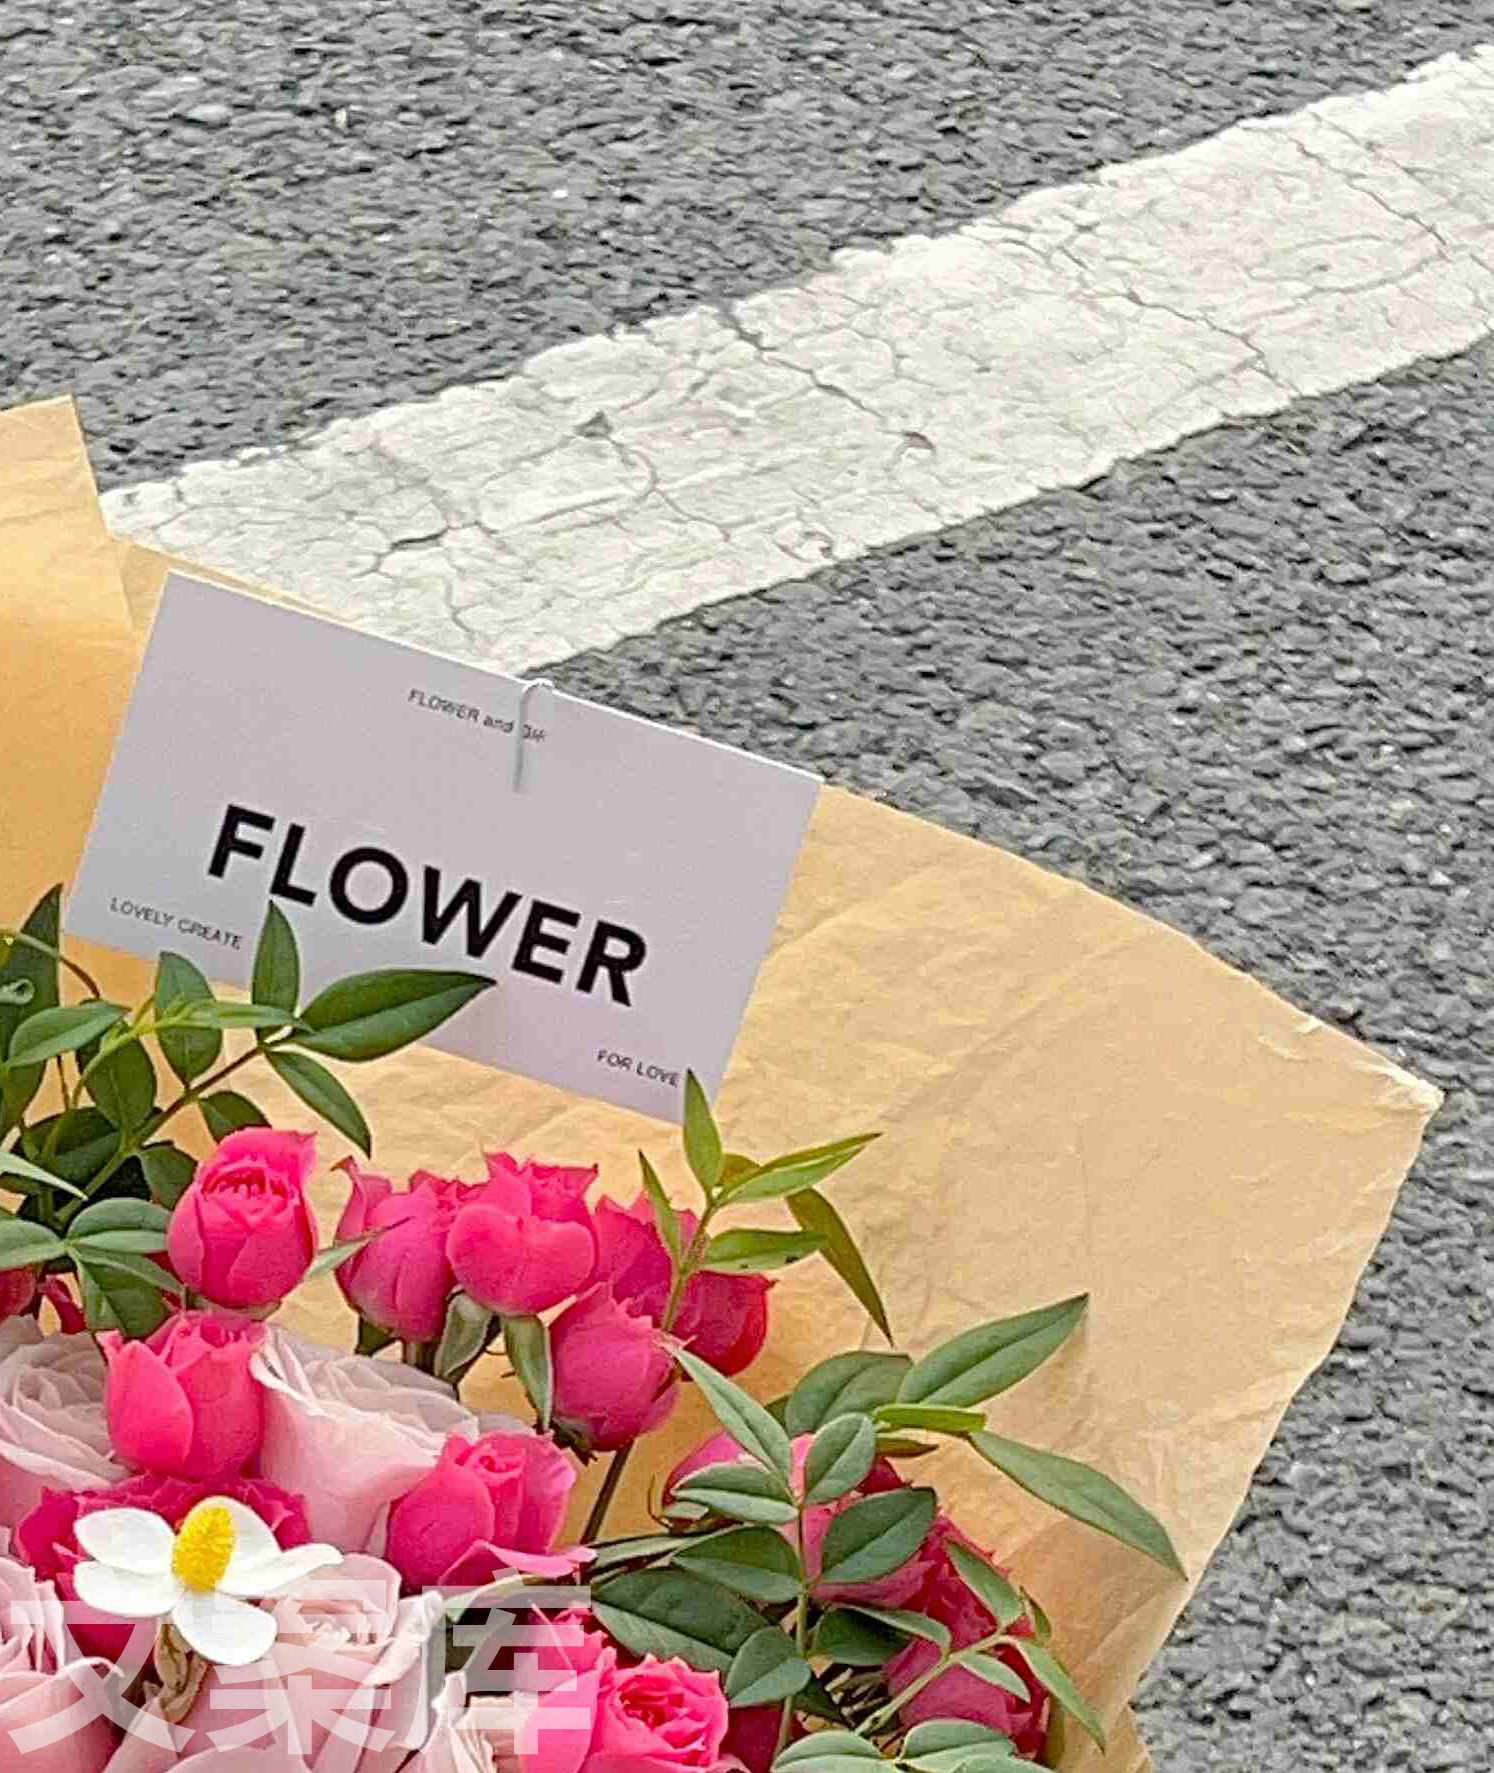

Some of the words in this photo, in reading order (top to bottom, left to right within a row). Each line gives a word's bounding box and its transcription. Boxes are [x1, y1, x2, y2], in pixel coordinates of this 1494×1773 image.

[407, 688, 480, 722] FLOWER
[109, 897, 174, 927] LOVELY
[177, 918, 242, 950] CREATE
[208, 804, 647, 1008] FLOWER
[596, 1049, 633, 1071] FOR
[635, 1061, 680, 1089] LOVE
